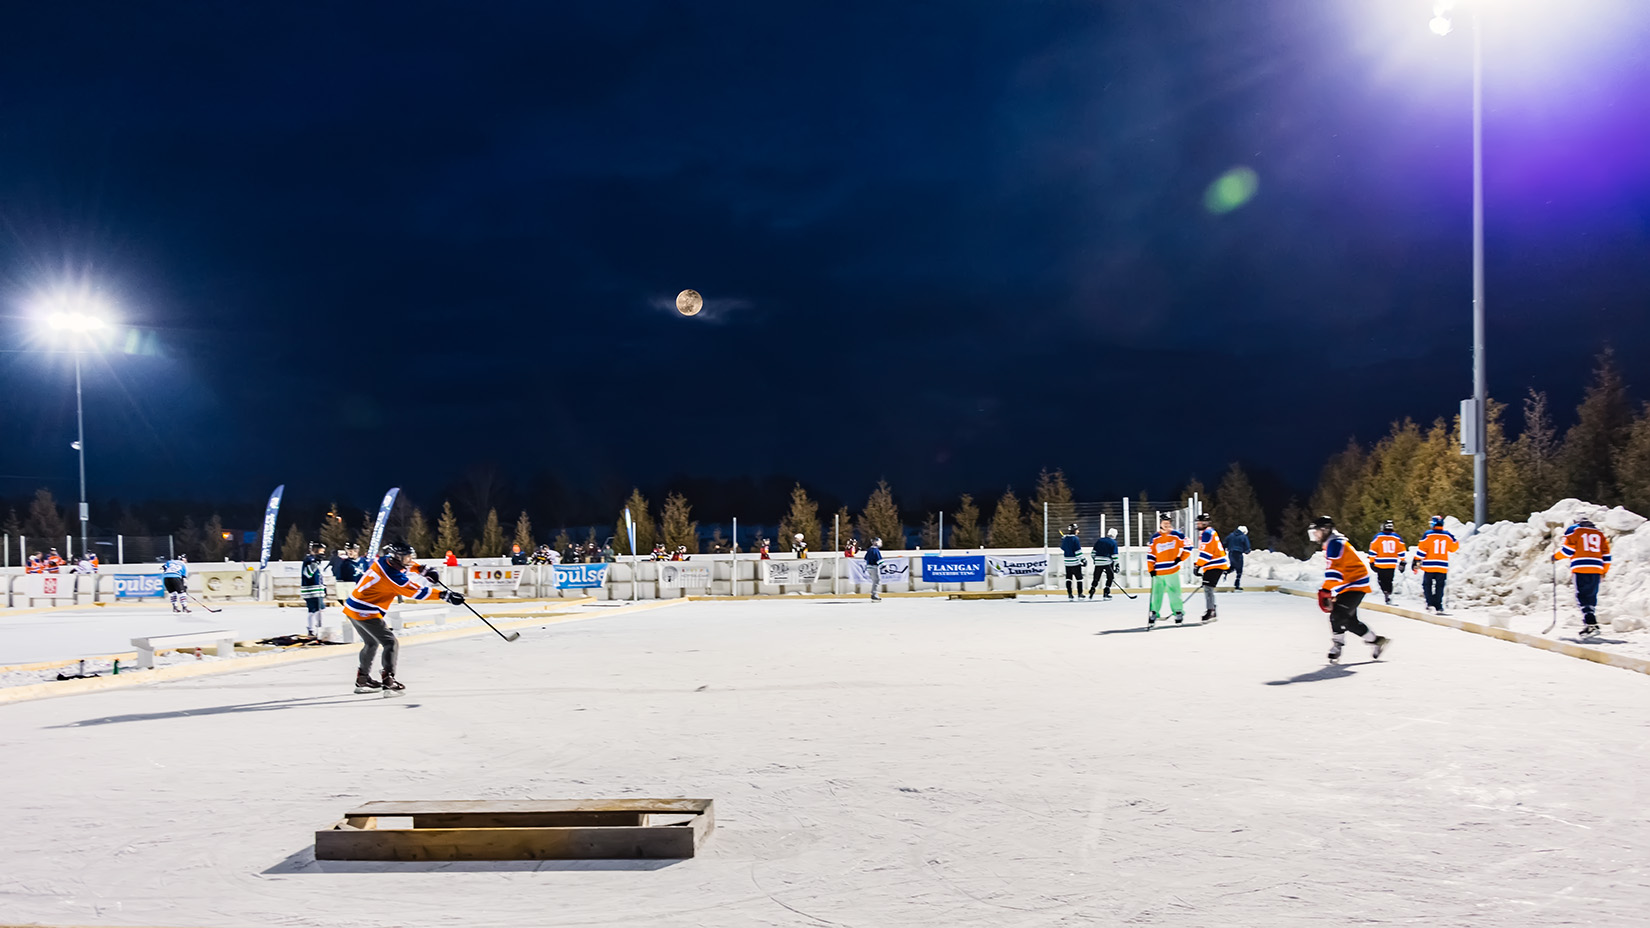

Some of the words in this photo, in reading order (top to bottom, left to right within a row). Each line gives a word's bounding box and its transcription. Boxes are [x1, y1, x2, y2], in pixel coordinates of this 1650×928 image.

[1381, 540, 1396, 554] 10
[1433, 539, 1446, 554] 11
[1581, 533, 1601, 552] 19
[1003, 560, 1047, 569] Lampert
[114, 575, 163, 595] pulse
[554, 566, 605, 587] pulse
